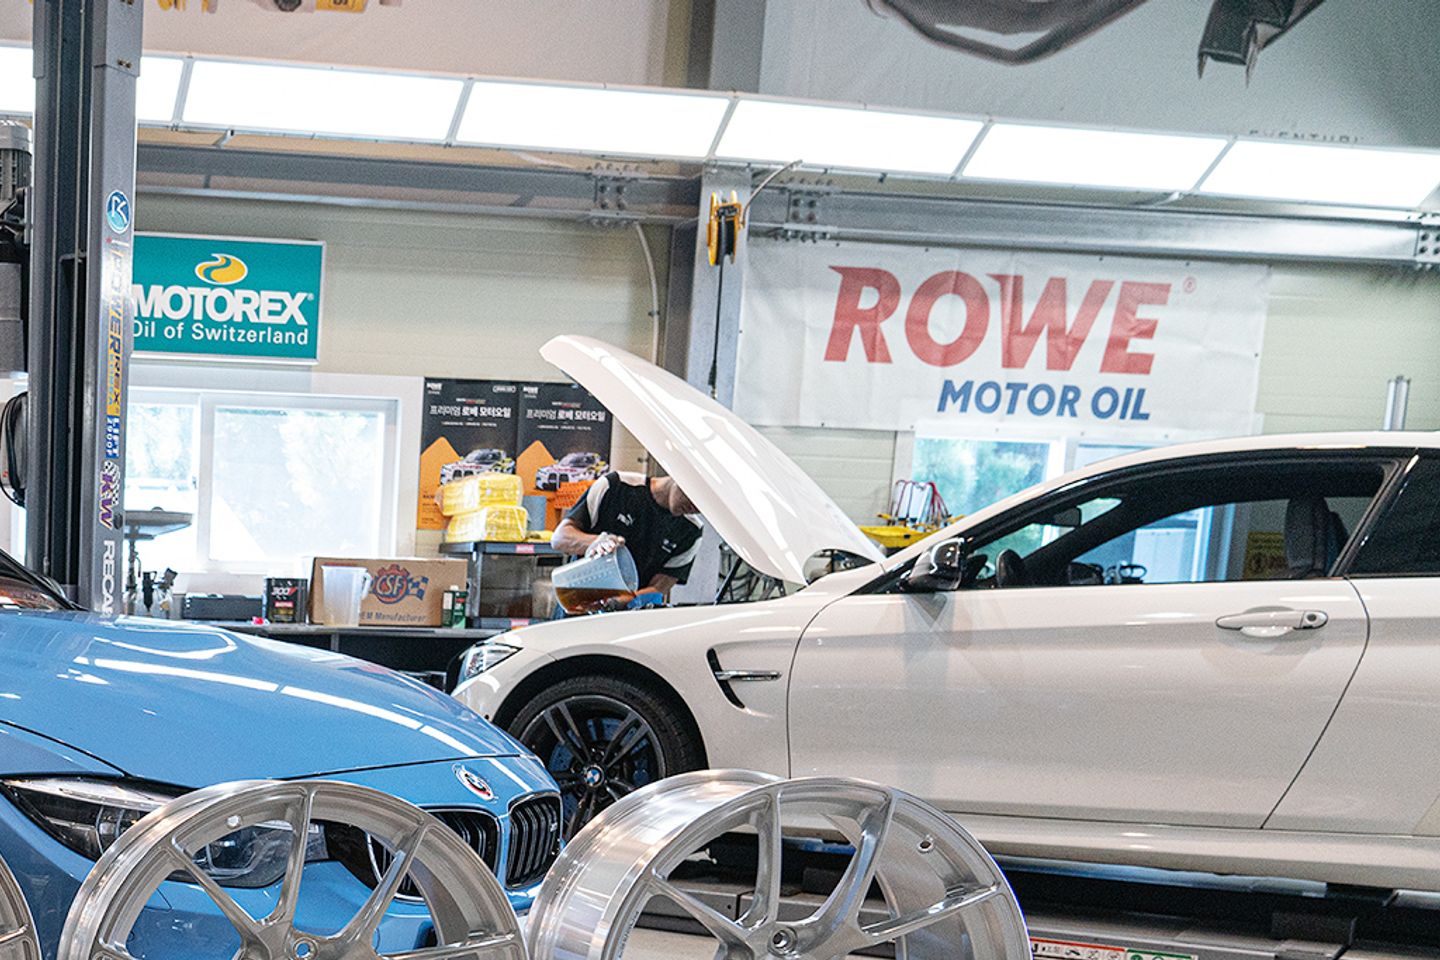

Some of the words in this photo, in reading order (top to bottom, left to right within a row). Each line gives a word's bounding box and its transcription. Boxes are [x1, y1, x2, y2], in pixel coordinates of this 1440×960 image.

[132, 284, 308, 326] MOTOREX
[824, 265, 1172, 375] ROWE
[164, 322, 184, 340] of
[192, 323, 309, 346] Switzerland
[937, 380, 1081, 418] MOTOR
[1091, 387, 1151, 421] OIL
[100, 473, 113, 529] KW
[376, 574, 405, 596] CSF
[375, 611, 426, 622] Manufacturer
